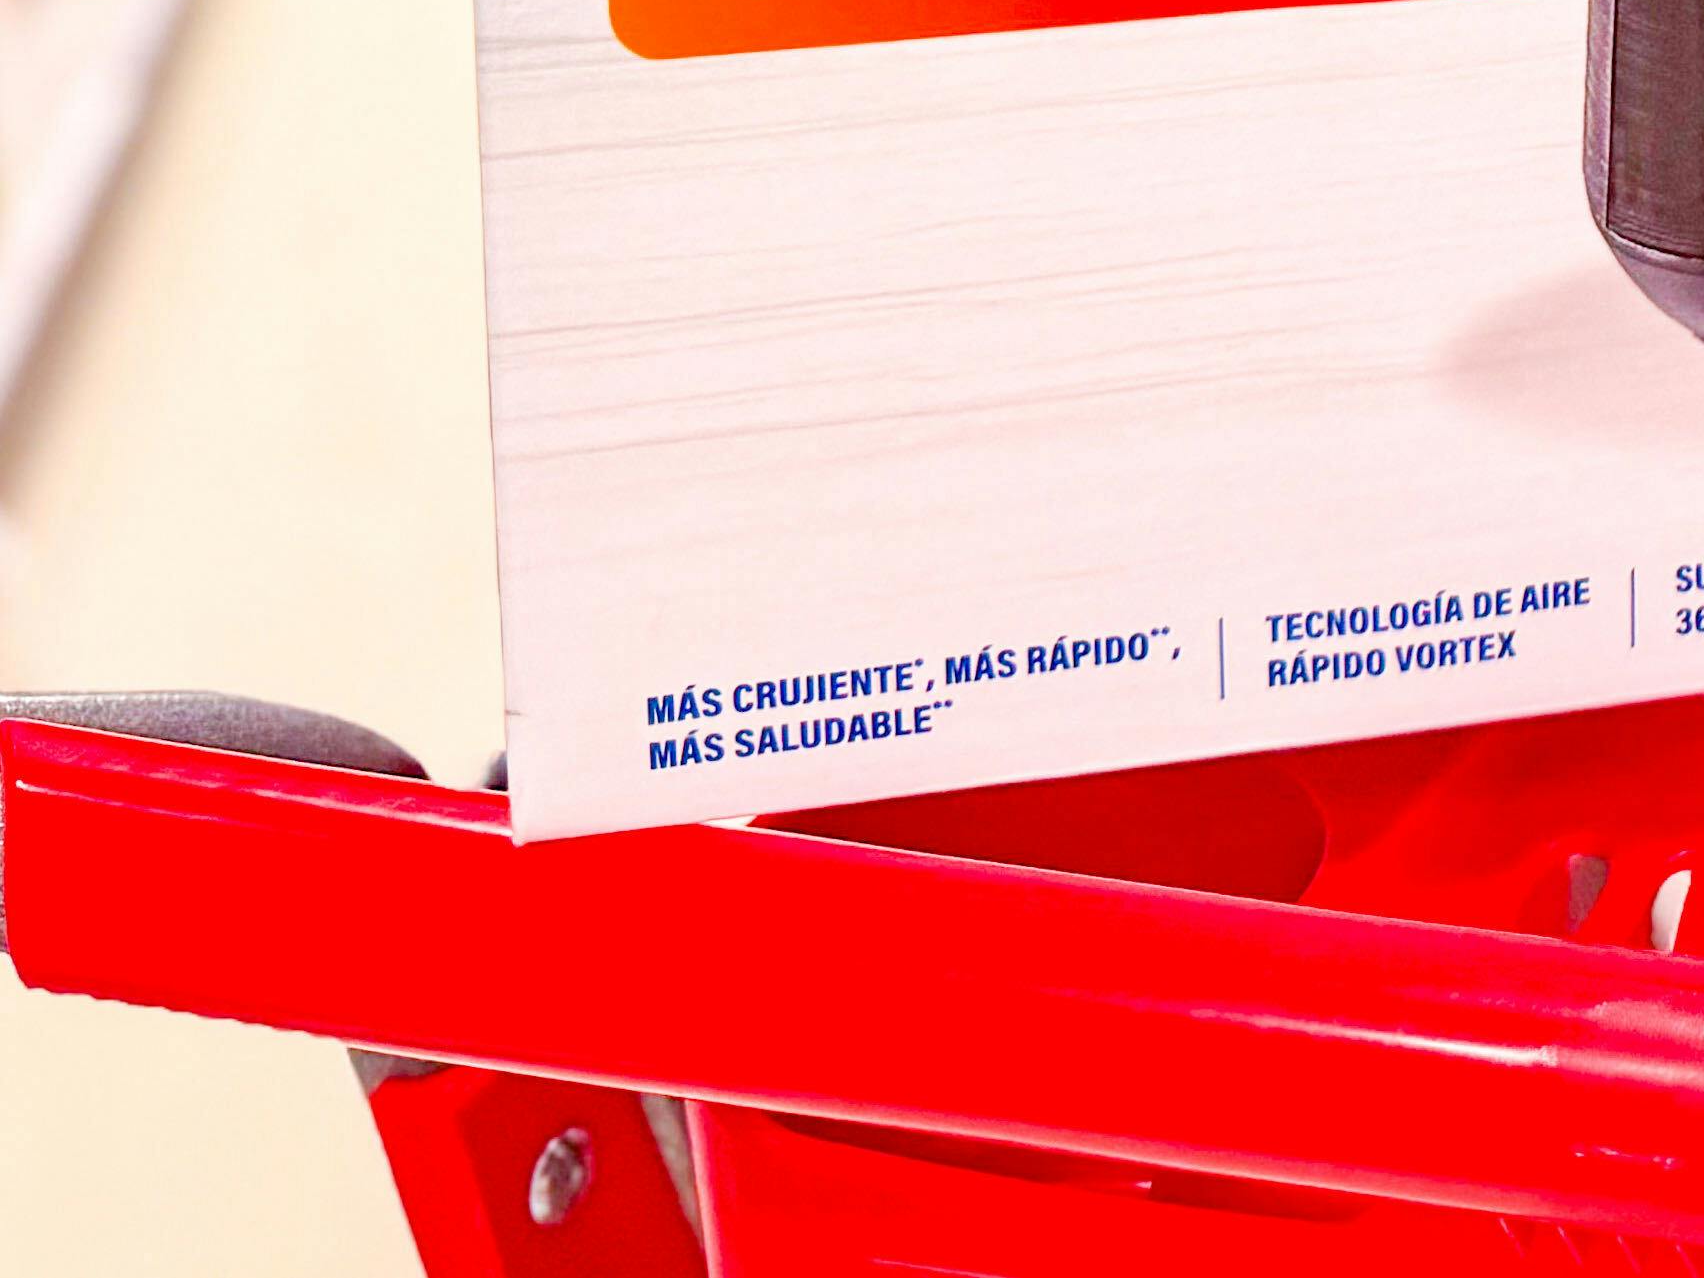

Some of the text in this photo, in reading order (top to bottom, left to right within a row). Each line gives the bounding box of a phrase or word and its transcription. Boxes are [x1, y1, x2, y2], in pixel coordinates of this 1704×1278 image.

[1266, 577, 1591, 643] TECNOLOGÍA DE AIRE
[647, 685, 723, 725] MÁS
[945, 645, 1017, 685] MÁS
[1268, 630, 1517, 687] RÁPIDO VORTEX
[649, 730, 725, 770] MÁS
